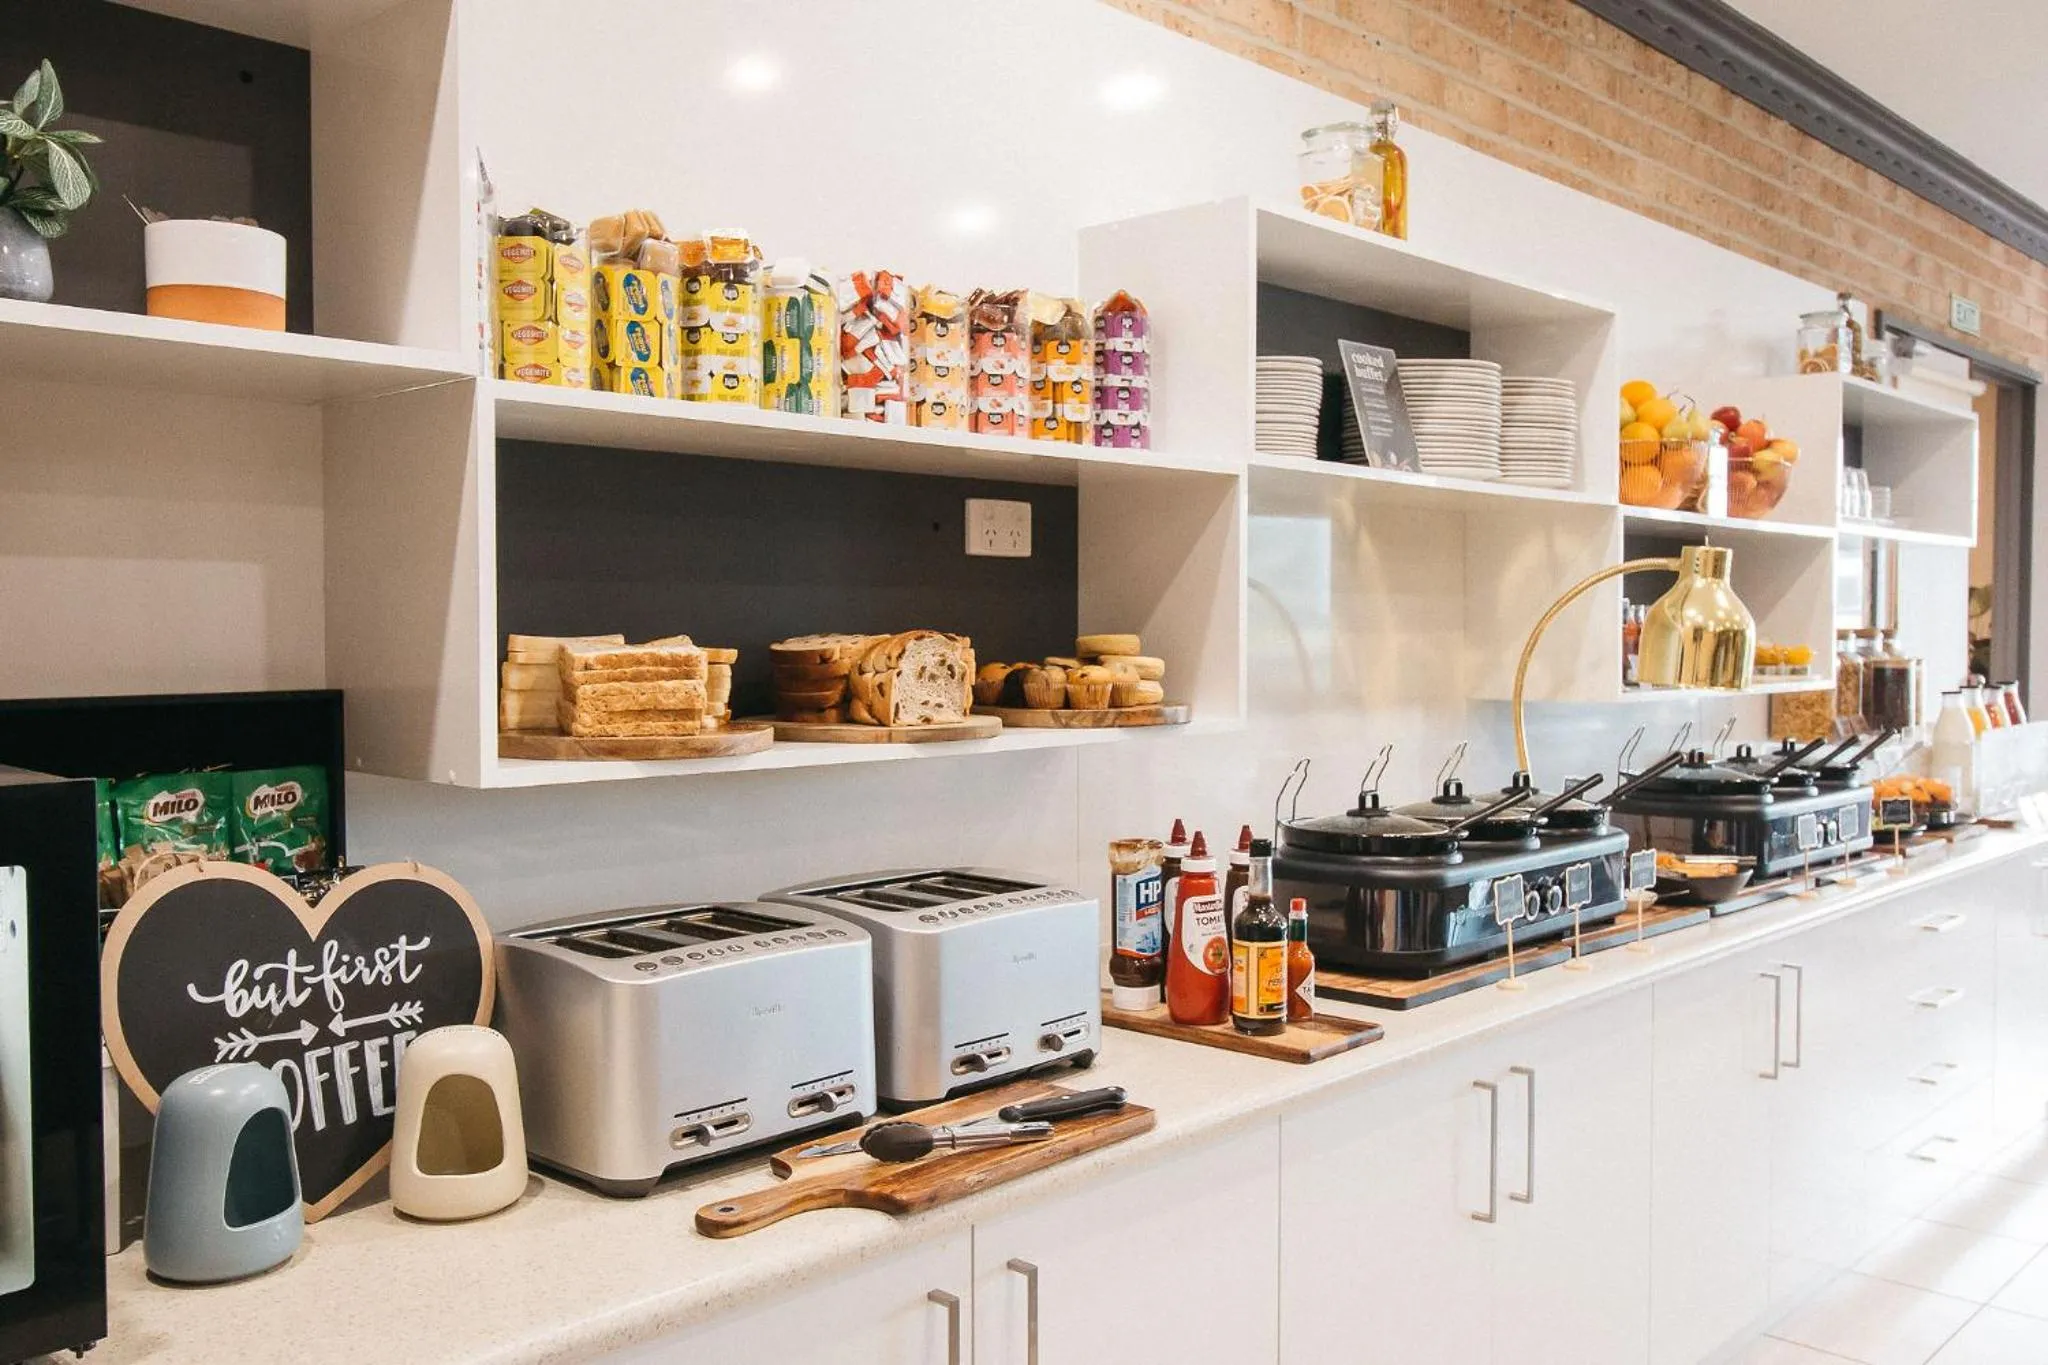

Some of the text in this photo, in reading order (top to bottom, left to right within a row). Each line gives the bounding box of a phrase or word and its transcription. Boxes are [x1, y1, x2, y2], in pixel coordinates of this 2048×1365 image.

[152, 798, 199, 817] MILO
[253, 791, 297, 811] MILO
[1139, 881, 1161, 904] HP
[187, 934, 430, 1018] but first
[270, 1029, 417, 1132] OFFE
